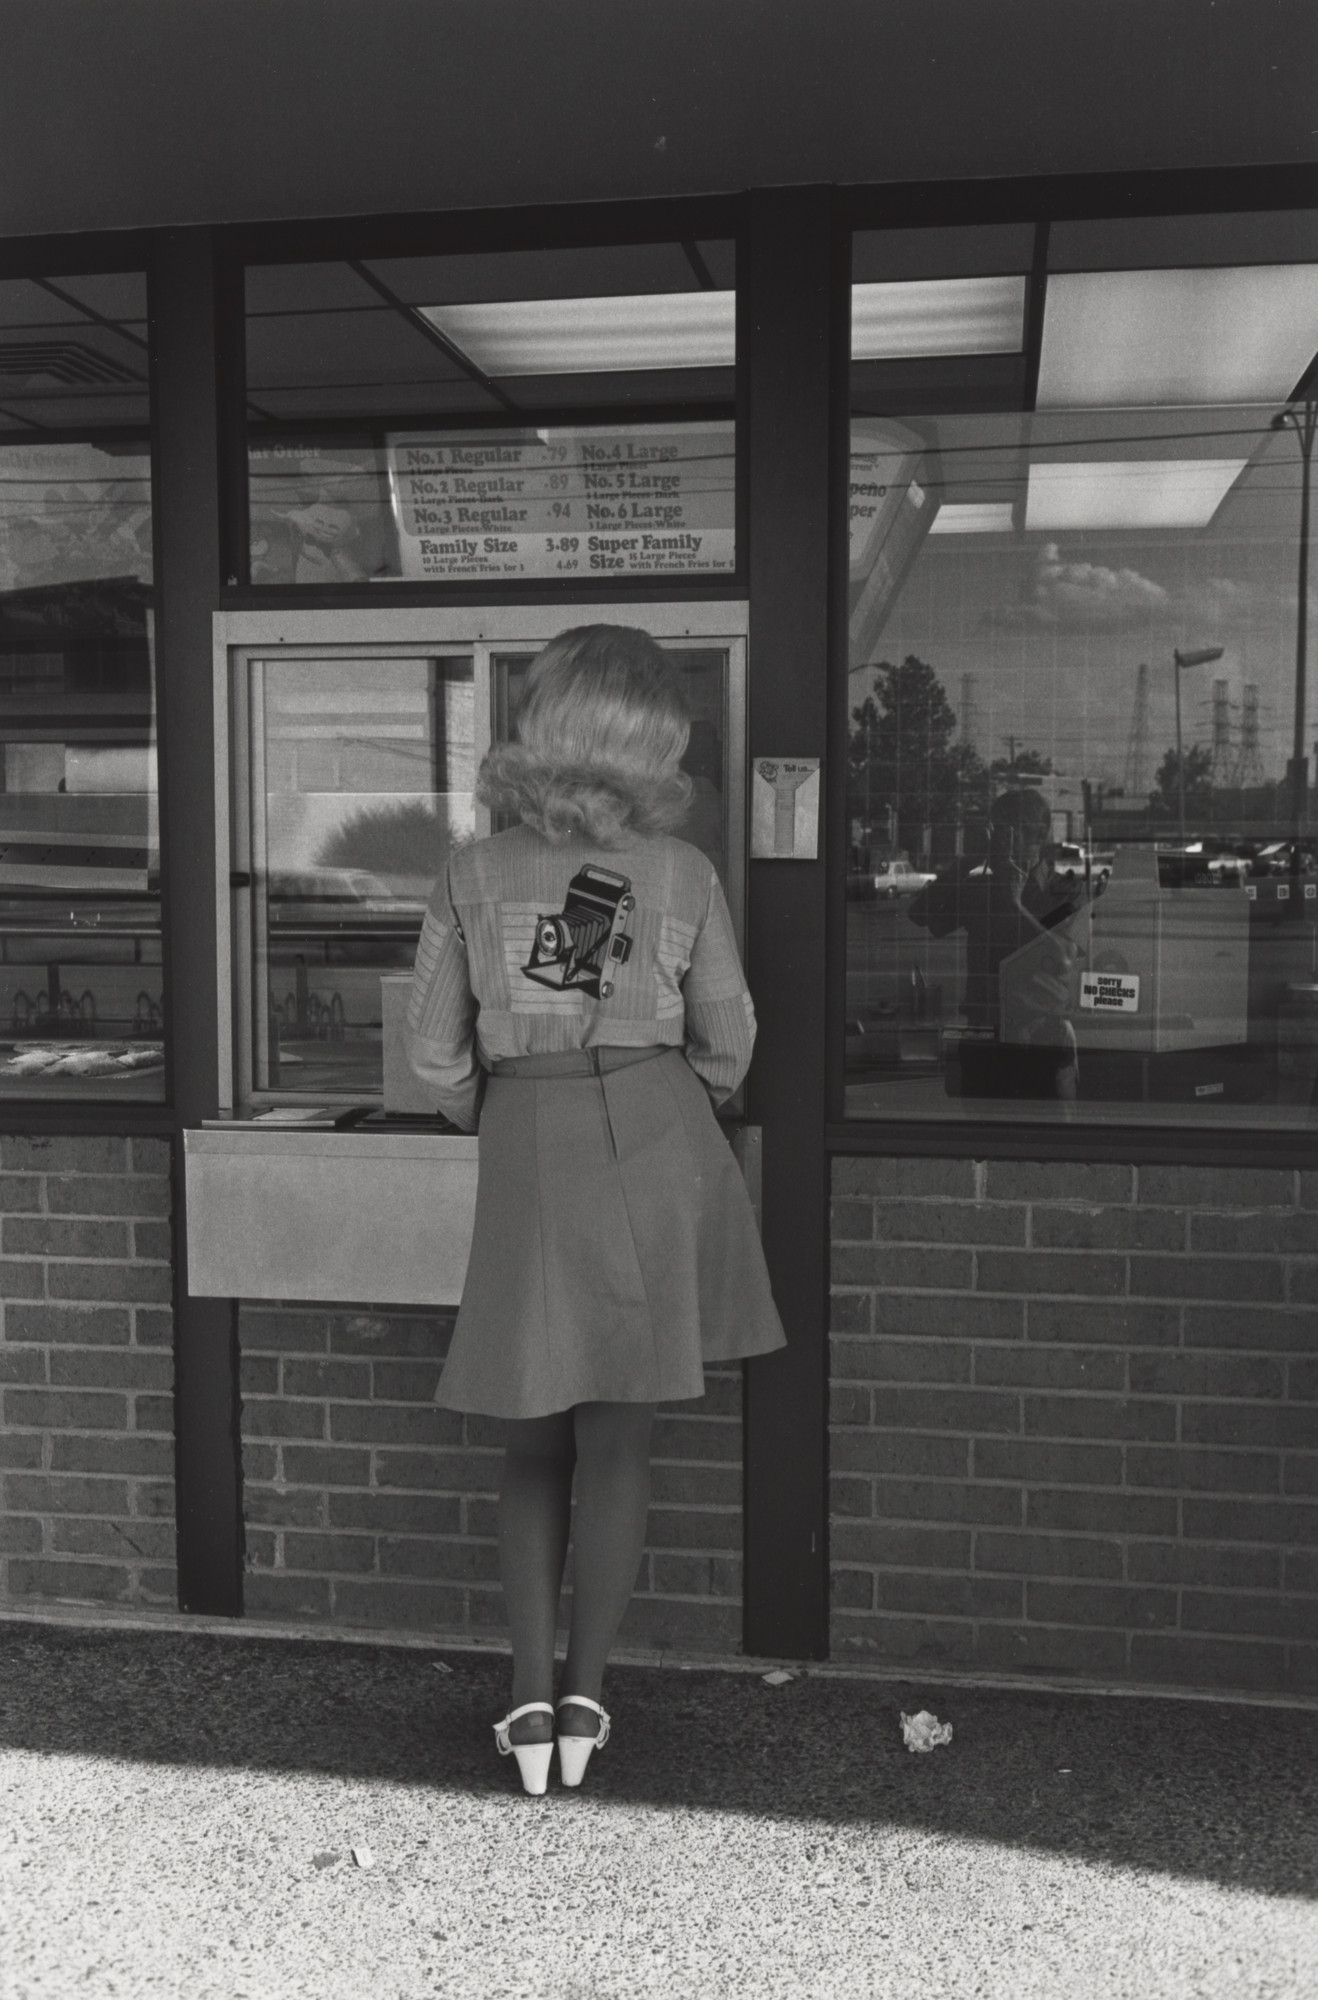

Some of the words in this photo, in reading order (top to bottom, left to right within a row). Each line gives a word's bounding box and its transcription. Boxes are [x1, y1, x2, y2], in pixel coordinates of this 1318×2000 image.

[451, 448, 522, 466] Regular
[626, 443, 678, 462] Large
[453, 477, 525, 496] Regular
[544, 474, 570, 489] .89
[629, 472, 681, 491] Large
[457, 506, 528, 525] Regular
[546, 502, 571, 518] .94
[632, 502, 683, 520] Large
[424, 525, 450, 534] Large
[597, 522, 622, 531] Large
[420, 539, 478, 556] Family
[483, 538, 518, 553] Size
[545, 536, 580, 552] 3.89
[588, 535, 639, 553] Super
[641, 533, 703, 551] Family
[433, 556, 459, 565] Large
[460, 554, 488, 563] Pieces
[589, 553, 625, 570] Size
[640, 551, 666, 560] Large
[668, 551, 697, 560] Pieces
[423, 565, 446, 574] with
[448, 564, 477, 573] French
[479, 563, 501, 572] Fries
[503, 563, 517, 571] for
[556, 560, 579, 570] 4.69
[630, 561, 652, 569] with
[654, 560, 685, 569] French
[687, 558, 710, 568] Fries
[712, 559, 727, 568] for
[783, 764, 797, 773] Tell
[1097, 977, 1122, 989] sorry
[1084, 985, 1098, 995] NO
[1099, 986, 1136, 998] CHECKS
[1094, 996, 1123, 1006] please
